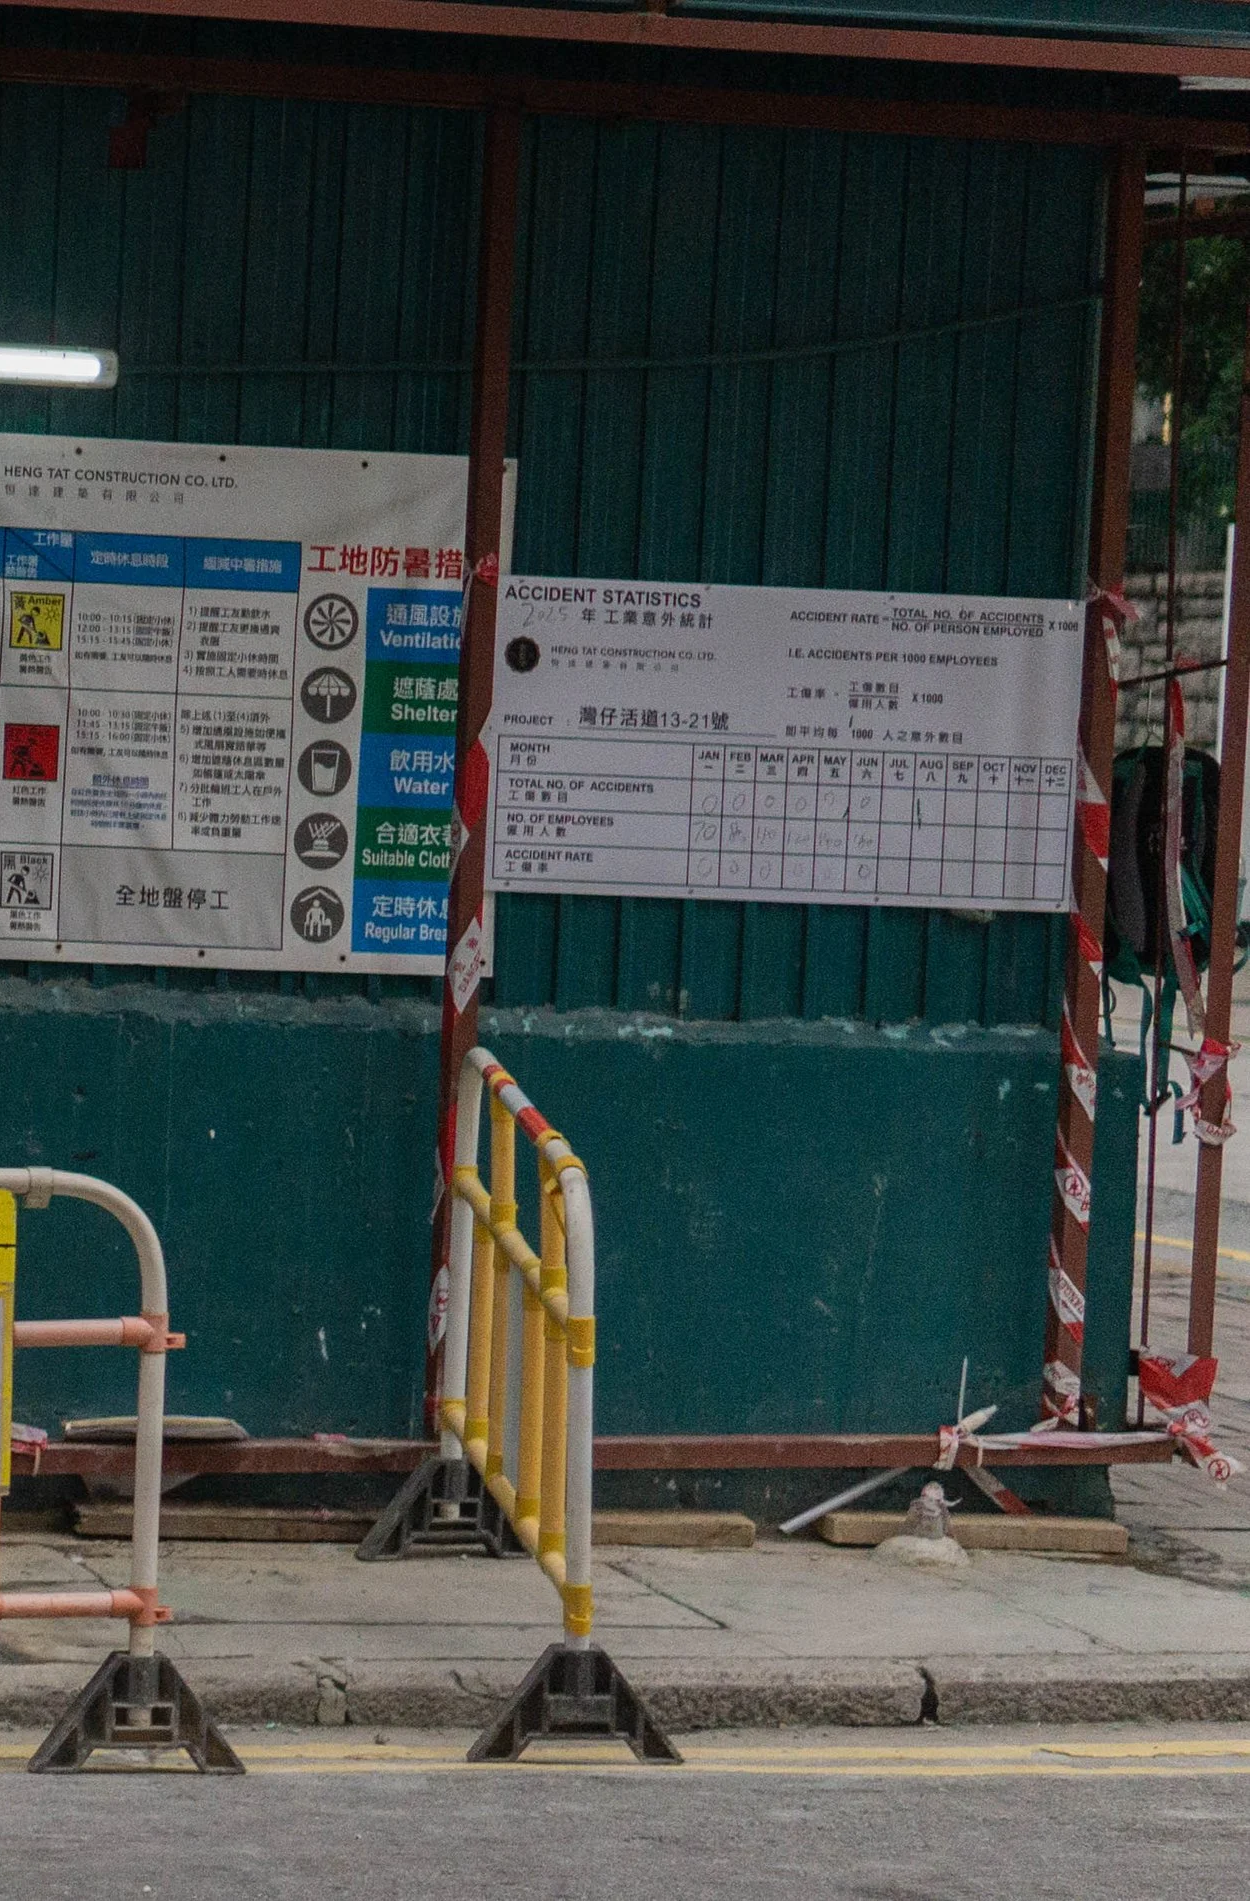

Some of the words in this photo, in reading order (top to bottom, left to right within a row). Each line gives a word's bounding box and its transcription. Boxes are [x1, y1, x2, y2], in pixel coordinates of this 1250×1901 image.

[5, 466, 42, 478] HENG
[48, 468, 70, 479] TAT
[74, 469, 180, 486] CONSTRUCTION
[184, 474, 208, 487] CO.
[212, 476, 238, 488] LTD.
[28, 595, 61, 605] Amber
[505, 585, 596, 603] ACCIDENT
[603, 590, 701, 608] STATISTICS
[582, 608, 596, 623] 年
[604, 609, 713, 629] 工業意外統計
[790, 611, 848, 623] ACCIDENT
[851, 614, 880, 625] RATE
[892, 608, 928, 619] TOTAL
[933, 610, 951, 620] NO.
[959, 611, 975, 620] OF
[979, 611, 1044, 624] ACCIDENTS
[891, 622, 911, 632] NO.
[914, 623, 931, 633] OF
[933, 623, 980, 635] PERSON
[983, 626, 1043, 638] EMPLOYED
[551, 645, 579, 655] HENG
[582, 646, 598, 656] TAT
[600, 648, 676, 659] CONSTRUCTION
[788, 648, 805, 659] I.E.
[807, 649, 872, 662] ACCIDENTS
[875, 651, 899, 663] PER
[902, 653, 926, 664] 1000
[928, 654, 998, 667] EMPLOYEES
[921, 693, 943, 704] 1000
[391, 703, 458, 722] Shelter
[504, 714, 554, 726] PROJECT
[851, 728, 873, 740] 1000
[510, 743, 551, 753] MONTH
[389, 749, 455, 774] 飲用水
[510, 754, 537, 766] 月份
[699, 751, 720, 760] JAN
[730, 752, 751, 762] FEB
[760, 753, 783, 763] MAR
[792, 755, 814, 764] APR
[824, 756, 846, 766] MAY
[857, 758, 878, 767] JUN
[890, 759, 909, 769] JUL
[920, 761, 943, 769] AUG
[952, 761, 974, 771] SEP
[983, 763, 1006, 772] OCT
[1014, 765, 1036, 773] NOV
[1045, 766, 1066, 775] DEC
[394, 777, 449, 795] Water
[509, 779, 543, 788] TOTAL
[546, 780, 566, 790] NO.
[569, 780, 585, 790] OF
[589, 782, 654, 794] ACCIDENTS
[507, 813, 527, 823] NO.
[529, 814, 545, 824] OF
[547, 815, 614, 827] EMPLOYEES
[20, 855, 48, 865] Black
[362, 848, 415, 867] Suitable
[505, 849, 562, 861] ACCIDENT
[565, 851, 593, 863] RATE
[116, 885, 229, 910] 全地盤停工
[364, 922, 416, 943] Regular
